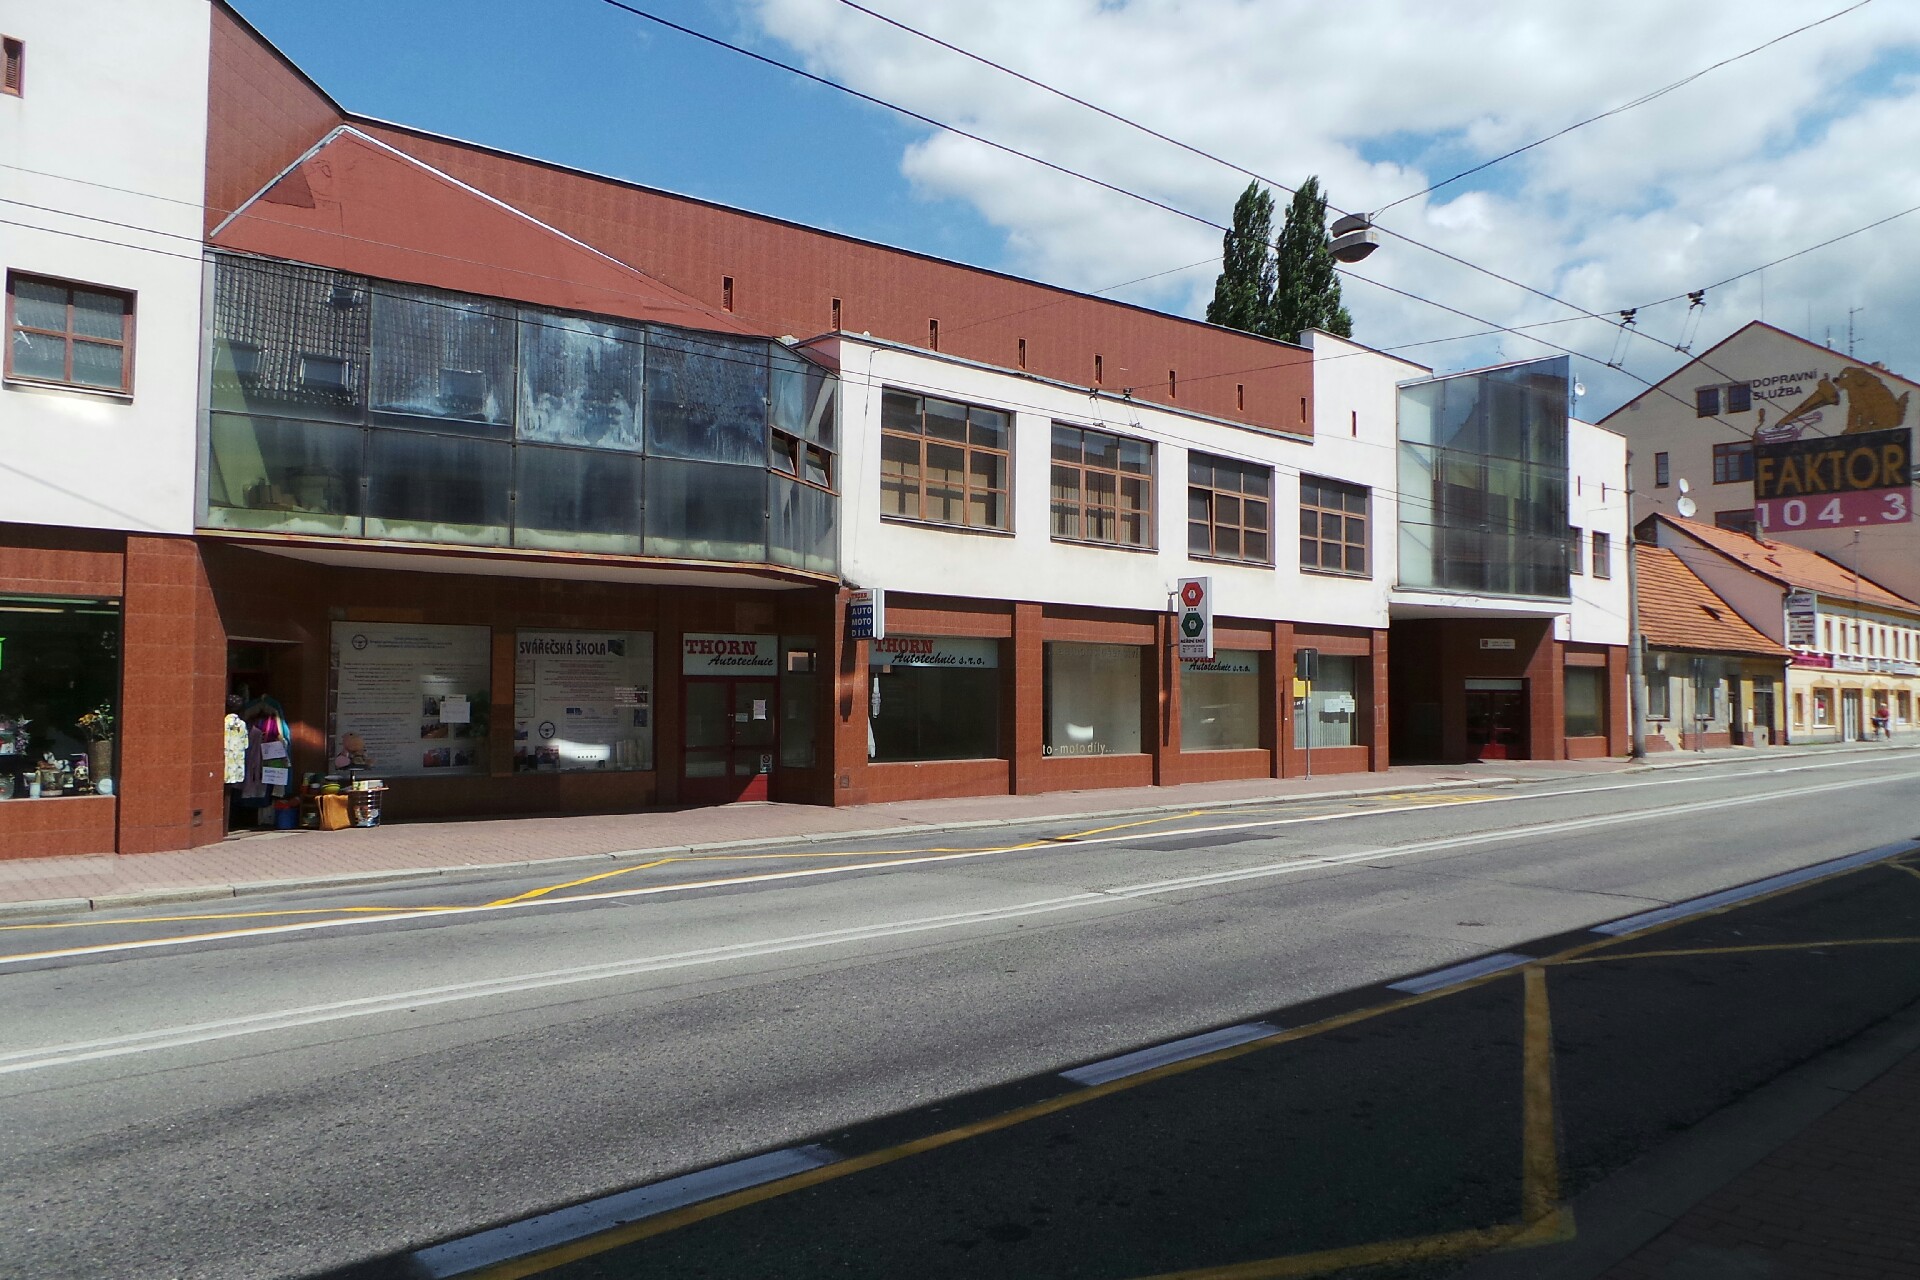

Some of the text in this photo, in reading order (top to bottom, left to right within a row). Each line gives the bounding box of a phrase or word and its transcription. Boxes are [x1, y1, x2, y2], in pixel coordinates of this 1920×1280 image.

[1752, 368, 1818, 388] DOPRAVNÍ
[1752, 385, 1803, 401] SLUŽBA
[1757, 444, 1906, 497] FAKTOR
[852, 607, 872, 615] AUTO
[852, 618, 872, 626] MOTO
[852, 628, 872, 637] DÍLY
[519, 638, 606, 656] SVÁŘEČSKÁ ŠKOLA
[685, 639, 758, 656] THORN
[874, 638, 934, 654] THORN
[708, 654, 774, 666] Autotechnic
[891, 652, 986, 665] Autotechnic s.r.o.
[1188, 660, 1232, 671] Autotechnic
